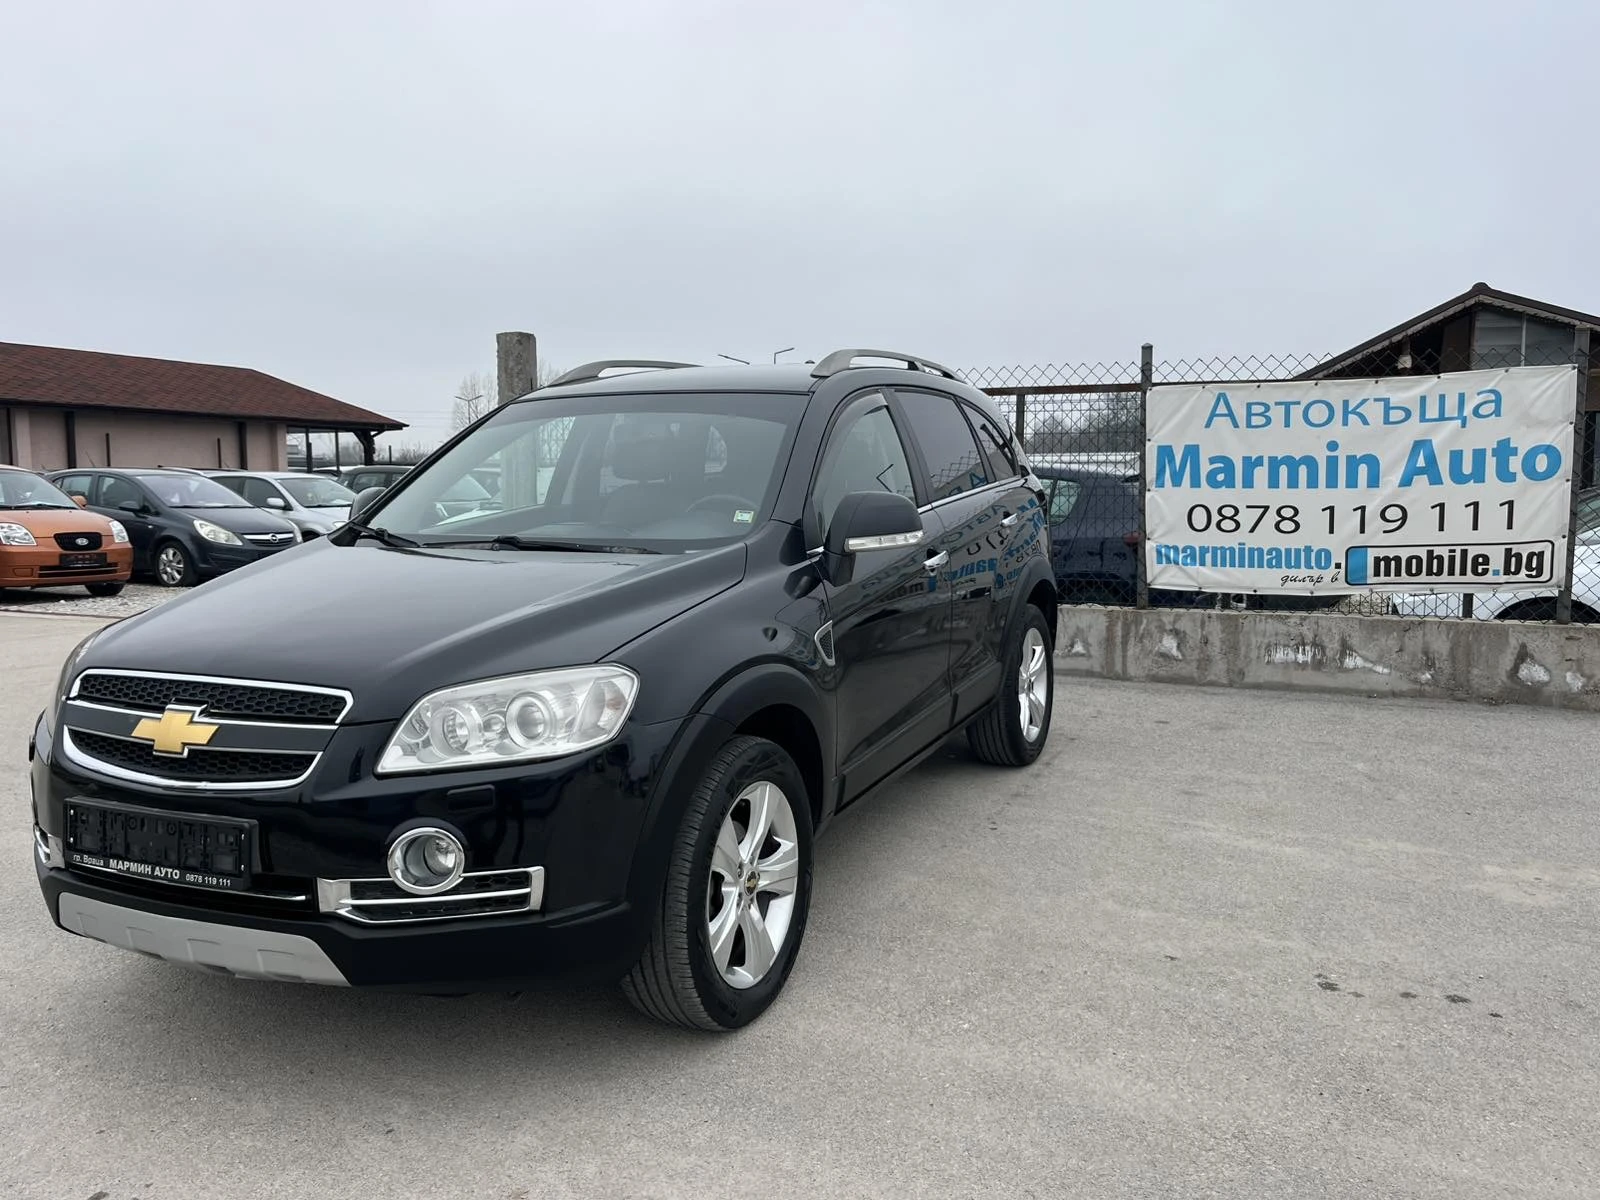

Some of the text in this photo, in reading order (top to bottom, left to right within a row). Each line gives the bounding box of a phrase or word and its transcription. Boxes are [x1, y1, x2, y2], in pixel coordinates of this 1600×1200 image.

[1204, 387, 1503, 430] Автокъща
[1154, 436, 1562, 489] Marmin Auto
[1186, 499, 1516, 535] 0878 119 111
[1373, 547, 1545, 579] mobile.bg
[109, 858, 152, 875] МАРМИН
[153, 866, 180, 880] АУТО
[185, 873, 203, 883] 0878
[204, 876, 217, 885] 119
[219, 878, 231, 887] 111
